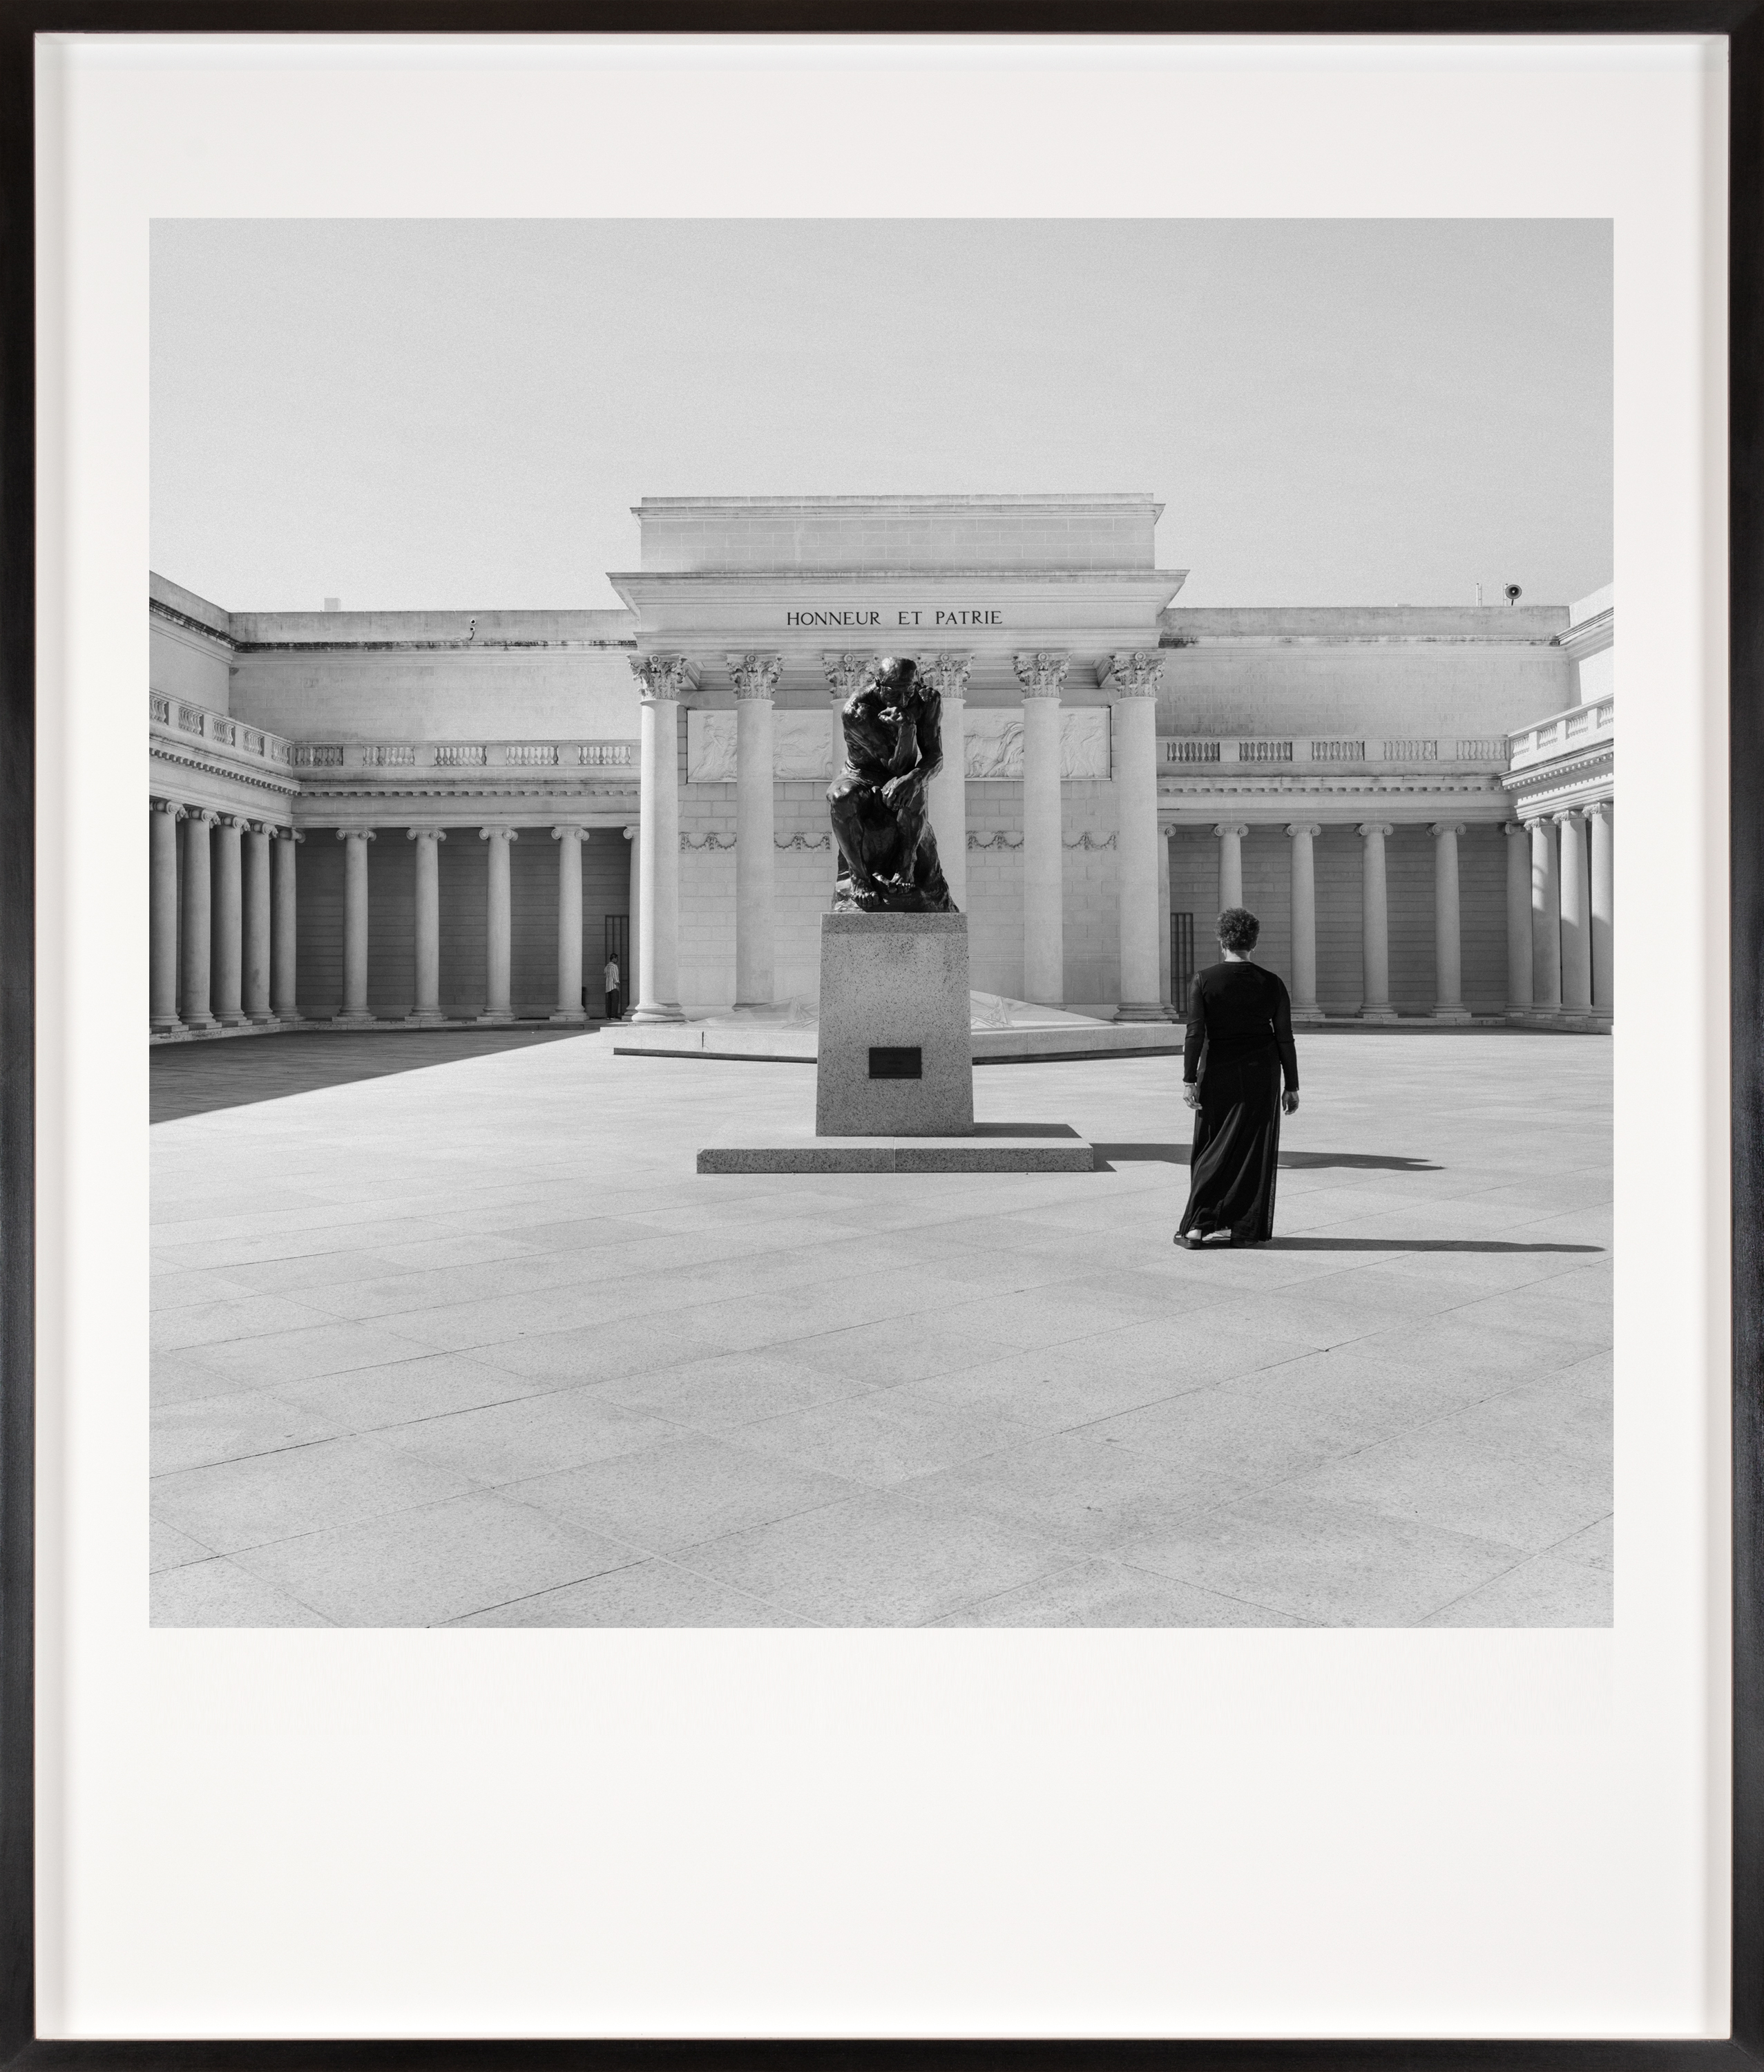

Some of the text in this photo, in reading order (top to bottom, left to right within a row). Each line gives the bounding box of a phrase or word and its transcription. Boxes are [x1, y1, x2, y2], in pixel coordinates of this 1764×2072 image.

[787, 611, 1003, 626] HONNEUR ET PATRIE
